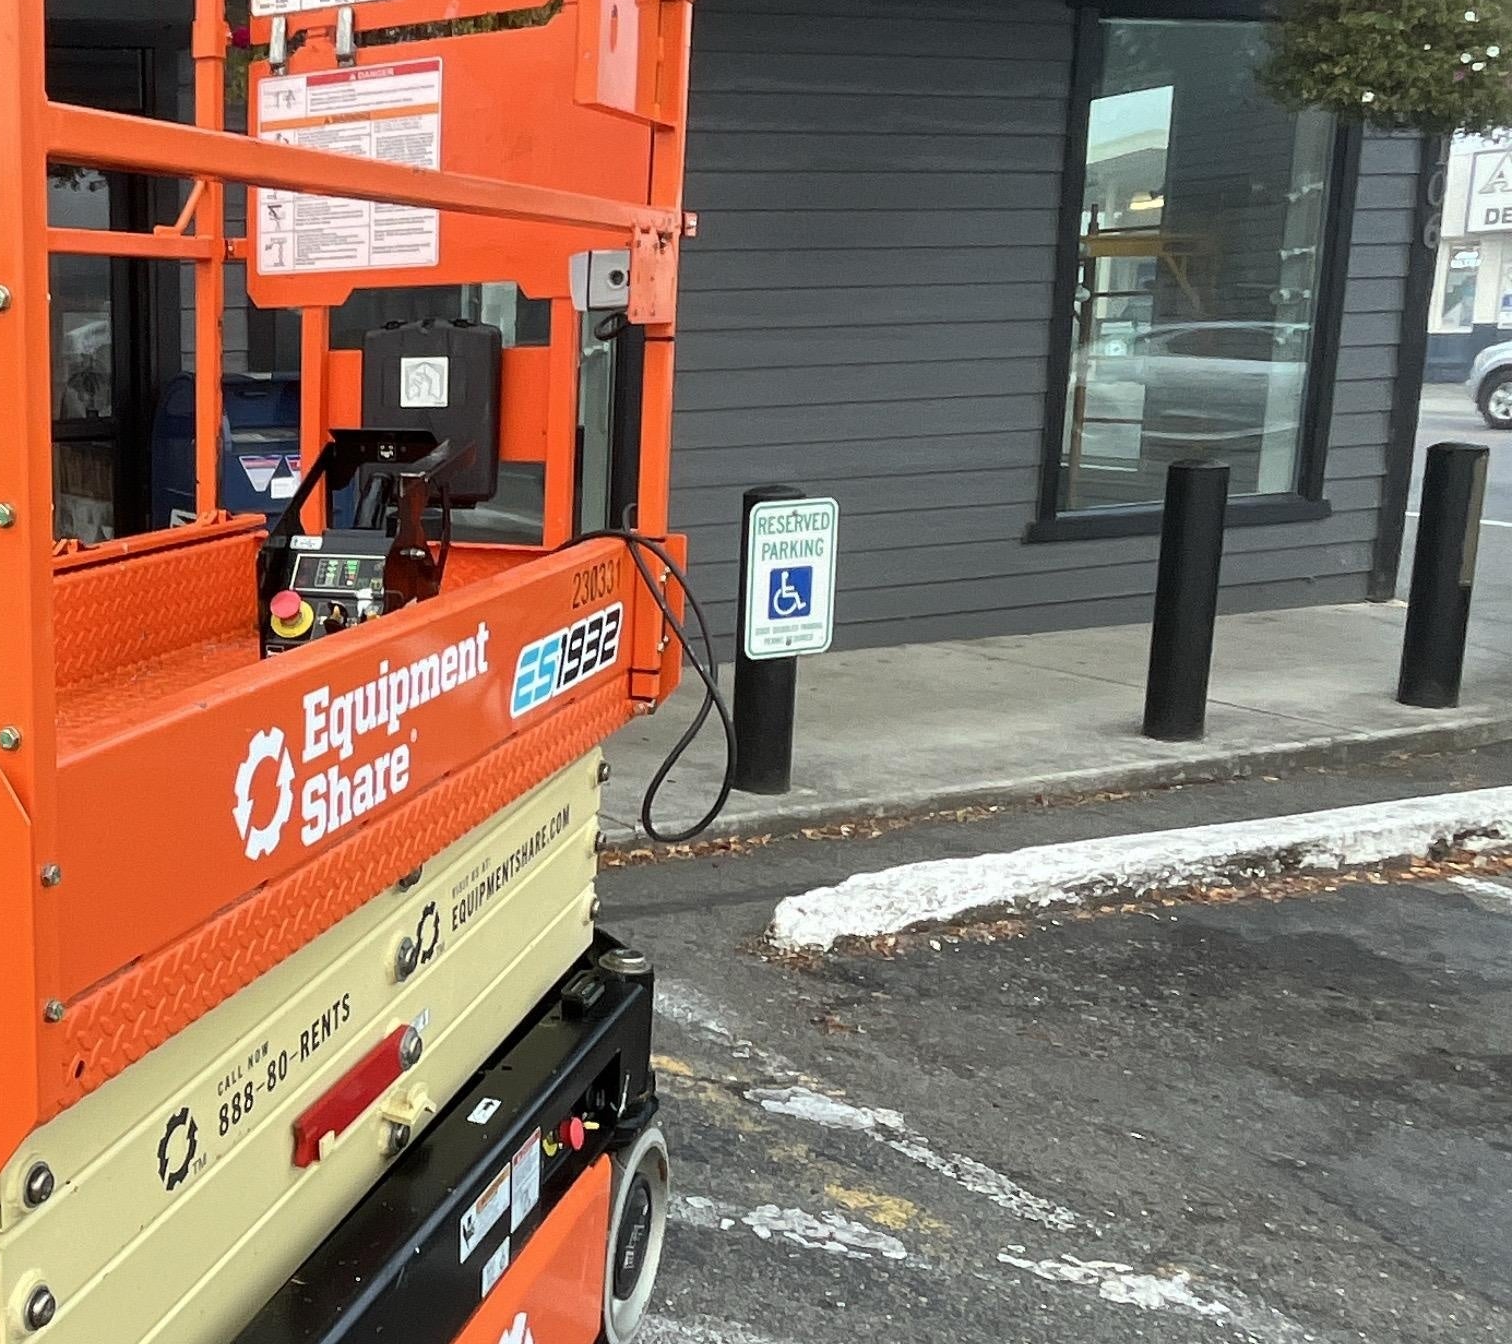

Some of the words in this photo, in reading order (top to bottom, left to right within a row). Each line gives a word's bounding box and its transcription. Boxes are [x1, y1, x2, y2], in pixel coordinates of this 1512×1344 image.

[757, 511, 830, 536] RESERVED
[761, 538, 825, 562] PARKING
[572, 559, 622, 610] 230331
[302, 620, 490, 764] Equipment
[512, 604, 622, 716] ES1932
[300, 743, 411, 848] Share
[451, 803, 571, 933] EQUIPMENTSHARE.COM
[216, 1064, 244, 1097] CALL
[247, 1040, 269, 1070] NOW
[218, 992, 351, 1137] 888-80-RENTS
